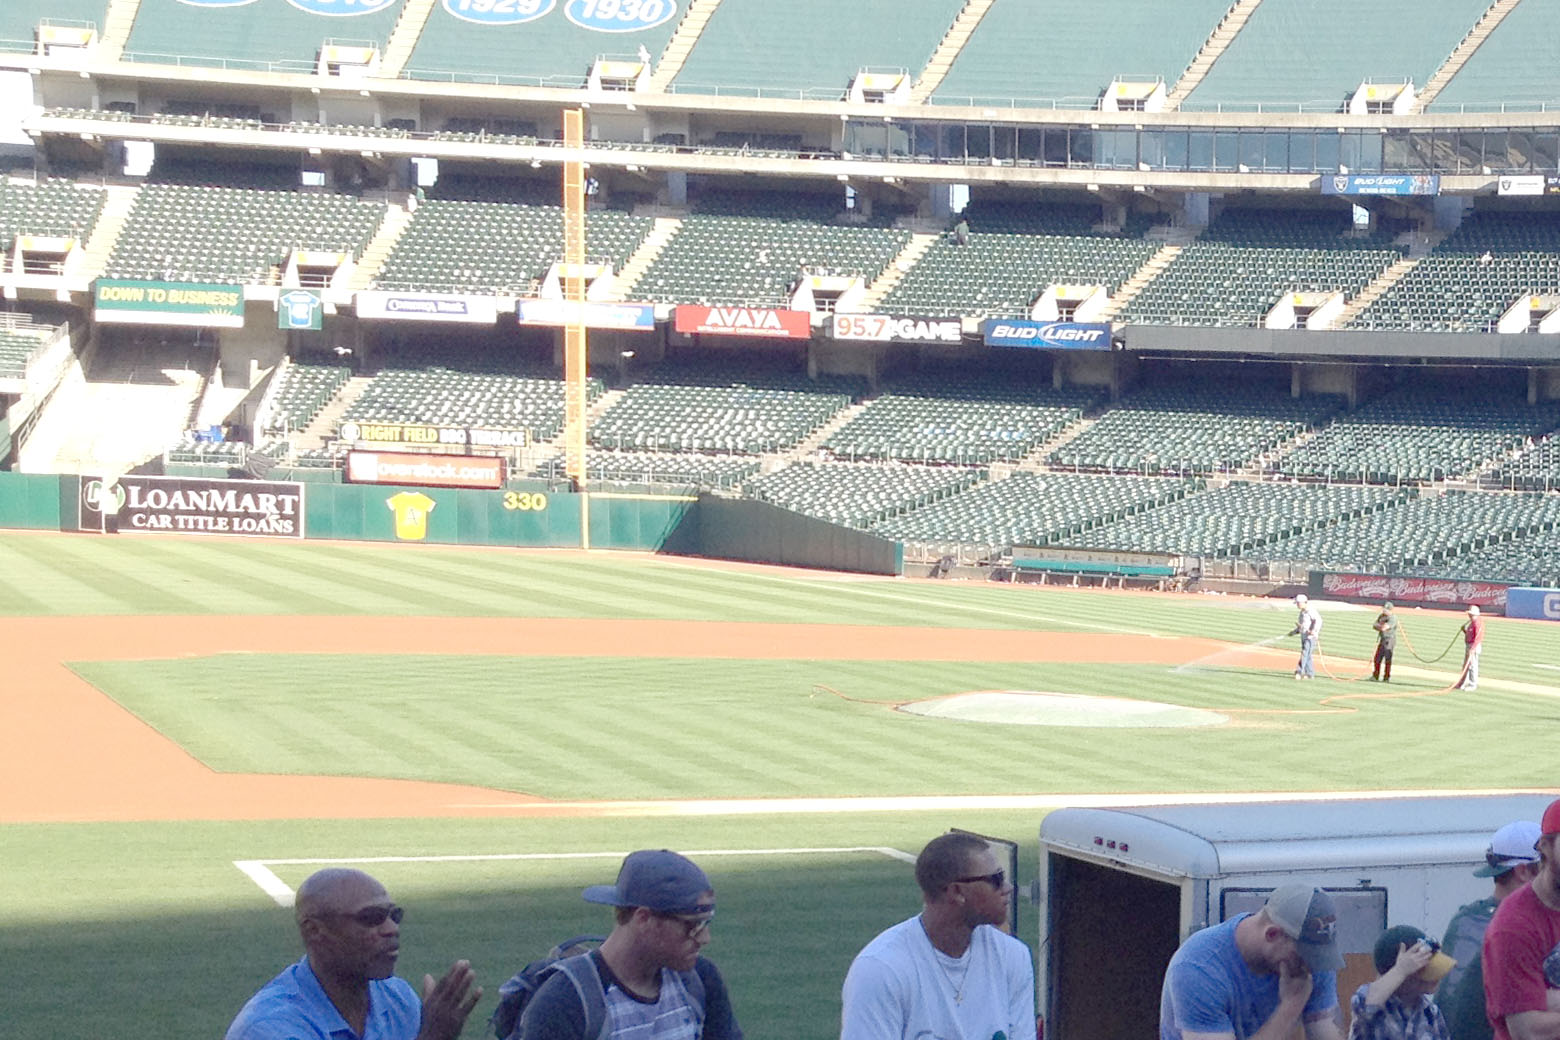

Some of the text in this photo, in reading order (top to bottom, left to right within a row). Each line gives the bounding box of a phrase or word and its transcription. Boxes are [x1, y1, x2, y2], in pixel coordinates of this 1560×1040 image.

[581, 0, 664, 23] 1930
[100, 286, 240, 306] DOWN TO BUSINESS
[704, 307, 783, 329] AVAYA
[837, 316, 888, 337] 95.7
[899, 318, 962, 341] GAME
[991, 325, 1104, 342] BUD LIGHT
[361, 425, 401, 442] RIGHT
[403, 426, 438, 443] FIELD
[377, 462, 497, 481] overstock.com
[502, 491, 548, 512] 330
[131, 513, 295, 533] CAR TITLE LOANS
